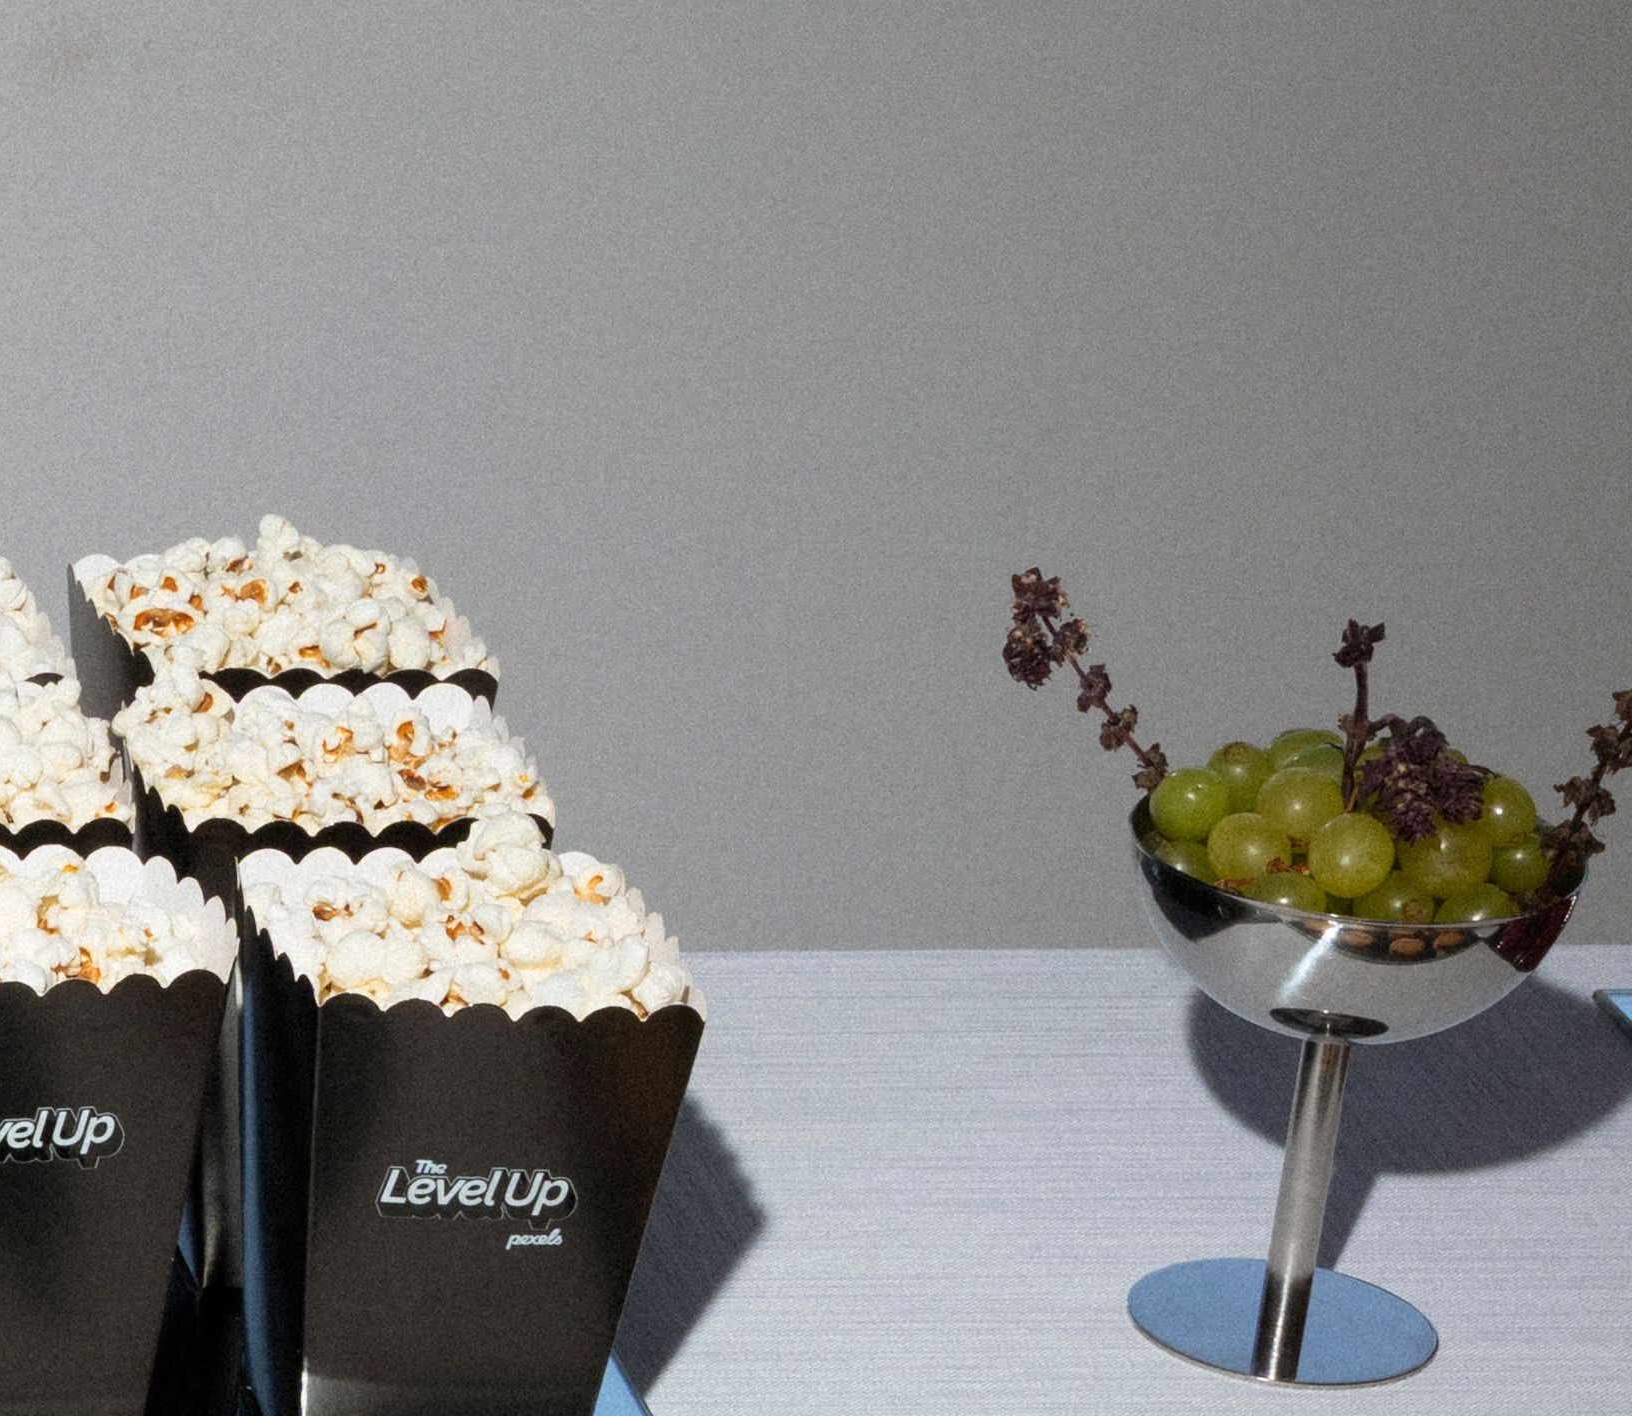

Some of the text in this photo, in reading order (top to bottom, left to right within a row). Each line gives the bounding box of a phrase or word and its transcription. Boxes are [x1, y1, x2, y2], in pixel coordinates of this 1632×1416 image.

[52, 1108, 117, 1158] Up
[414, 1159, 448, 1175] The
[379, 1168, 571, 1218] Level Up
[505, 1227, 564, 1251] pexels
